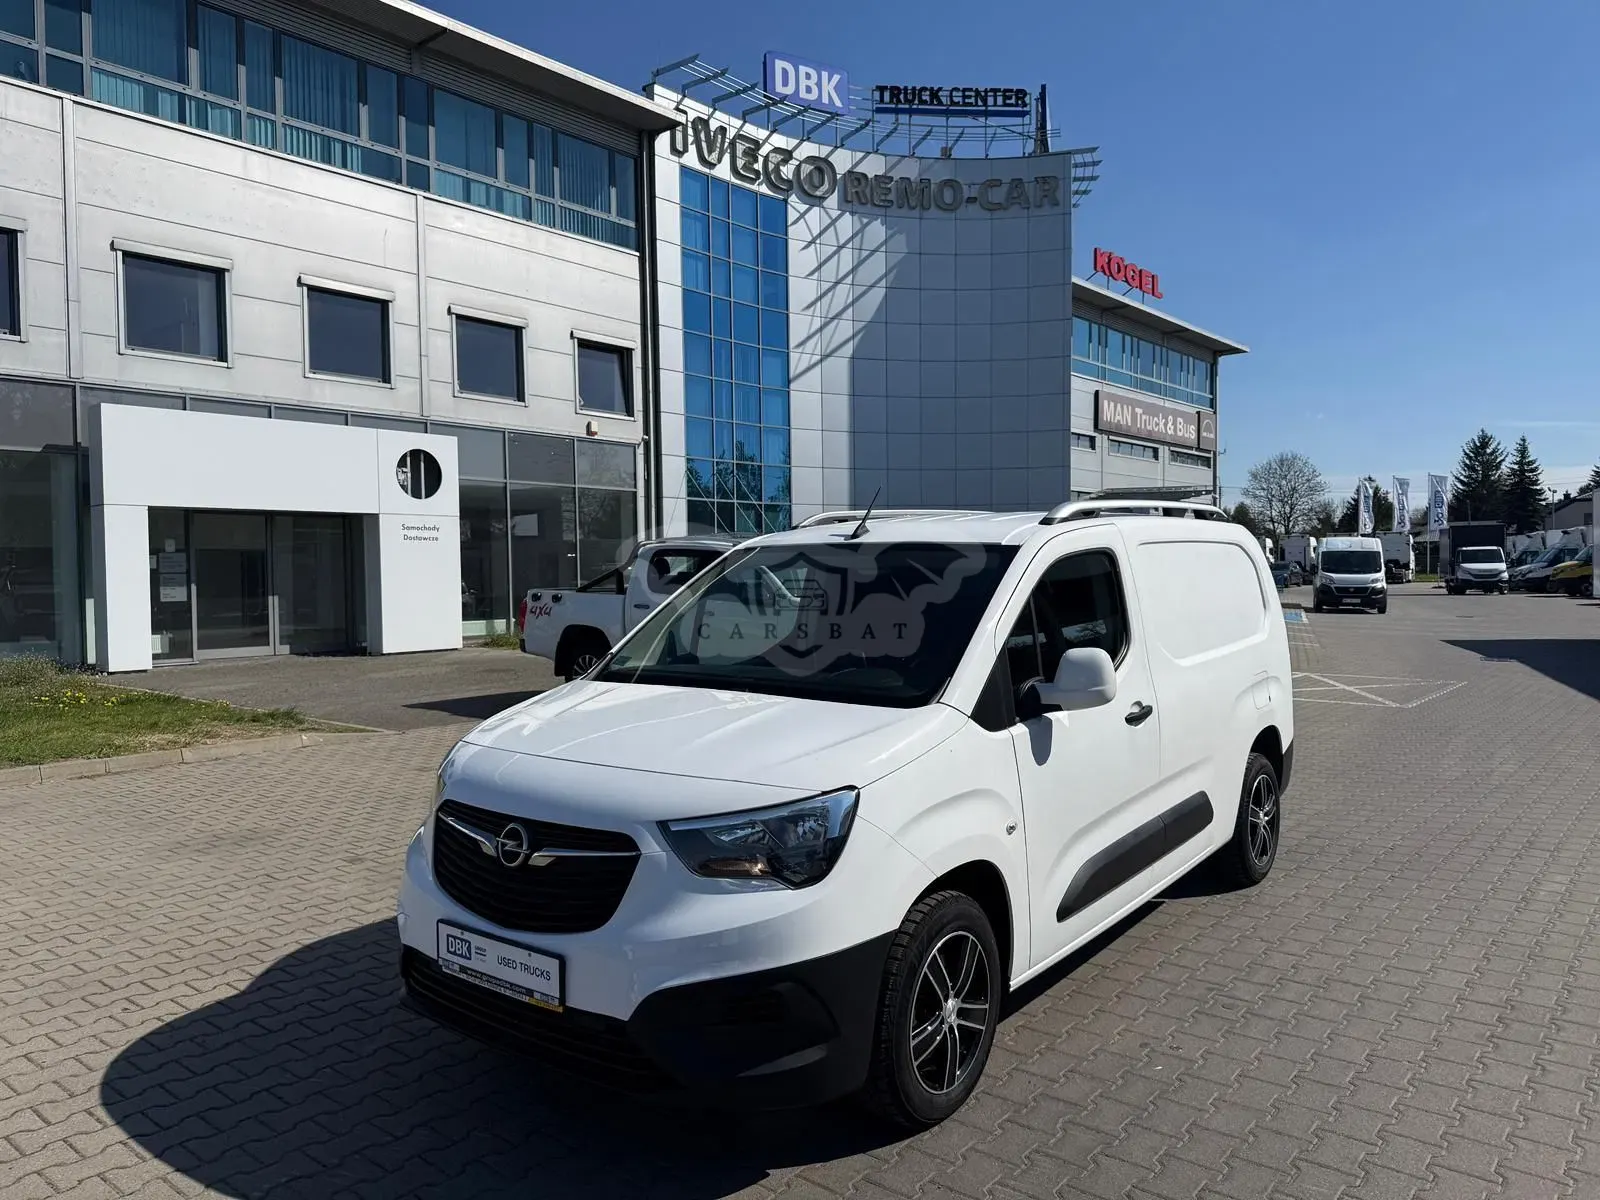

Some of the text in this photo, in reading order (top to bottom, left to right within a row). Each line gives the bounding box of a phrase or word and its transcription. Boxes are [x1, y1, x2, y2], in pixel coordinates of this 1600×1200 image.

[774, 57, 844, 109] DBK
[874, 84, 1029, 108] TRUCK CENTER
[669, 108, 1062, 213] IVECO REMO-CAR
[1103, 399, 1196, 440] MAN Truck & Bus
[401, 523, 440, 533] Samochody
[403, 534, 439, 542] Dostawcze
[448, 936, 470, 958] DBK
[497, 955, 551, 981] USED TRUCKS
